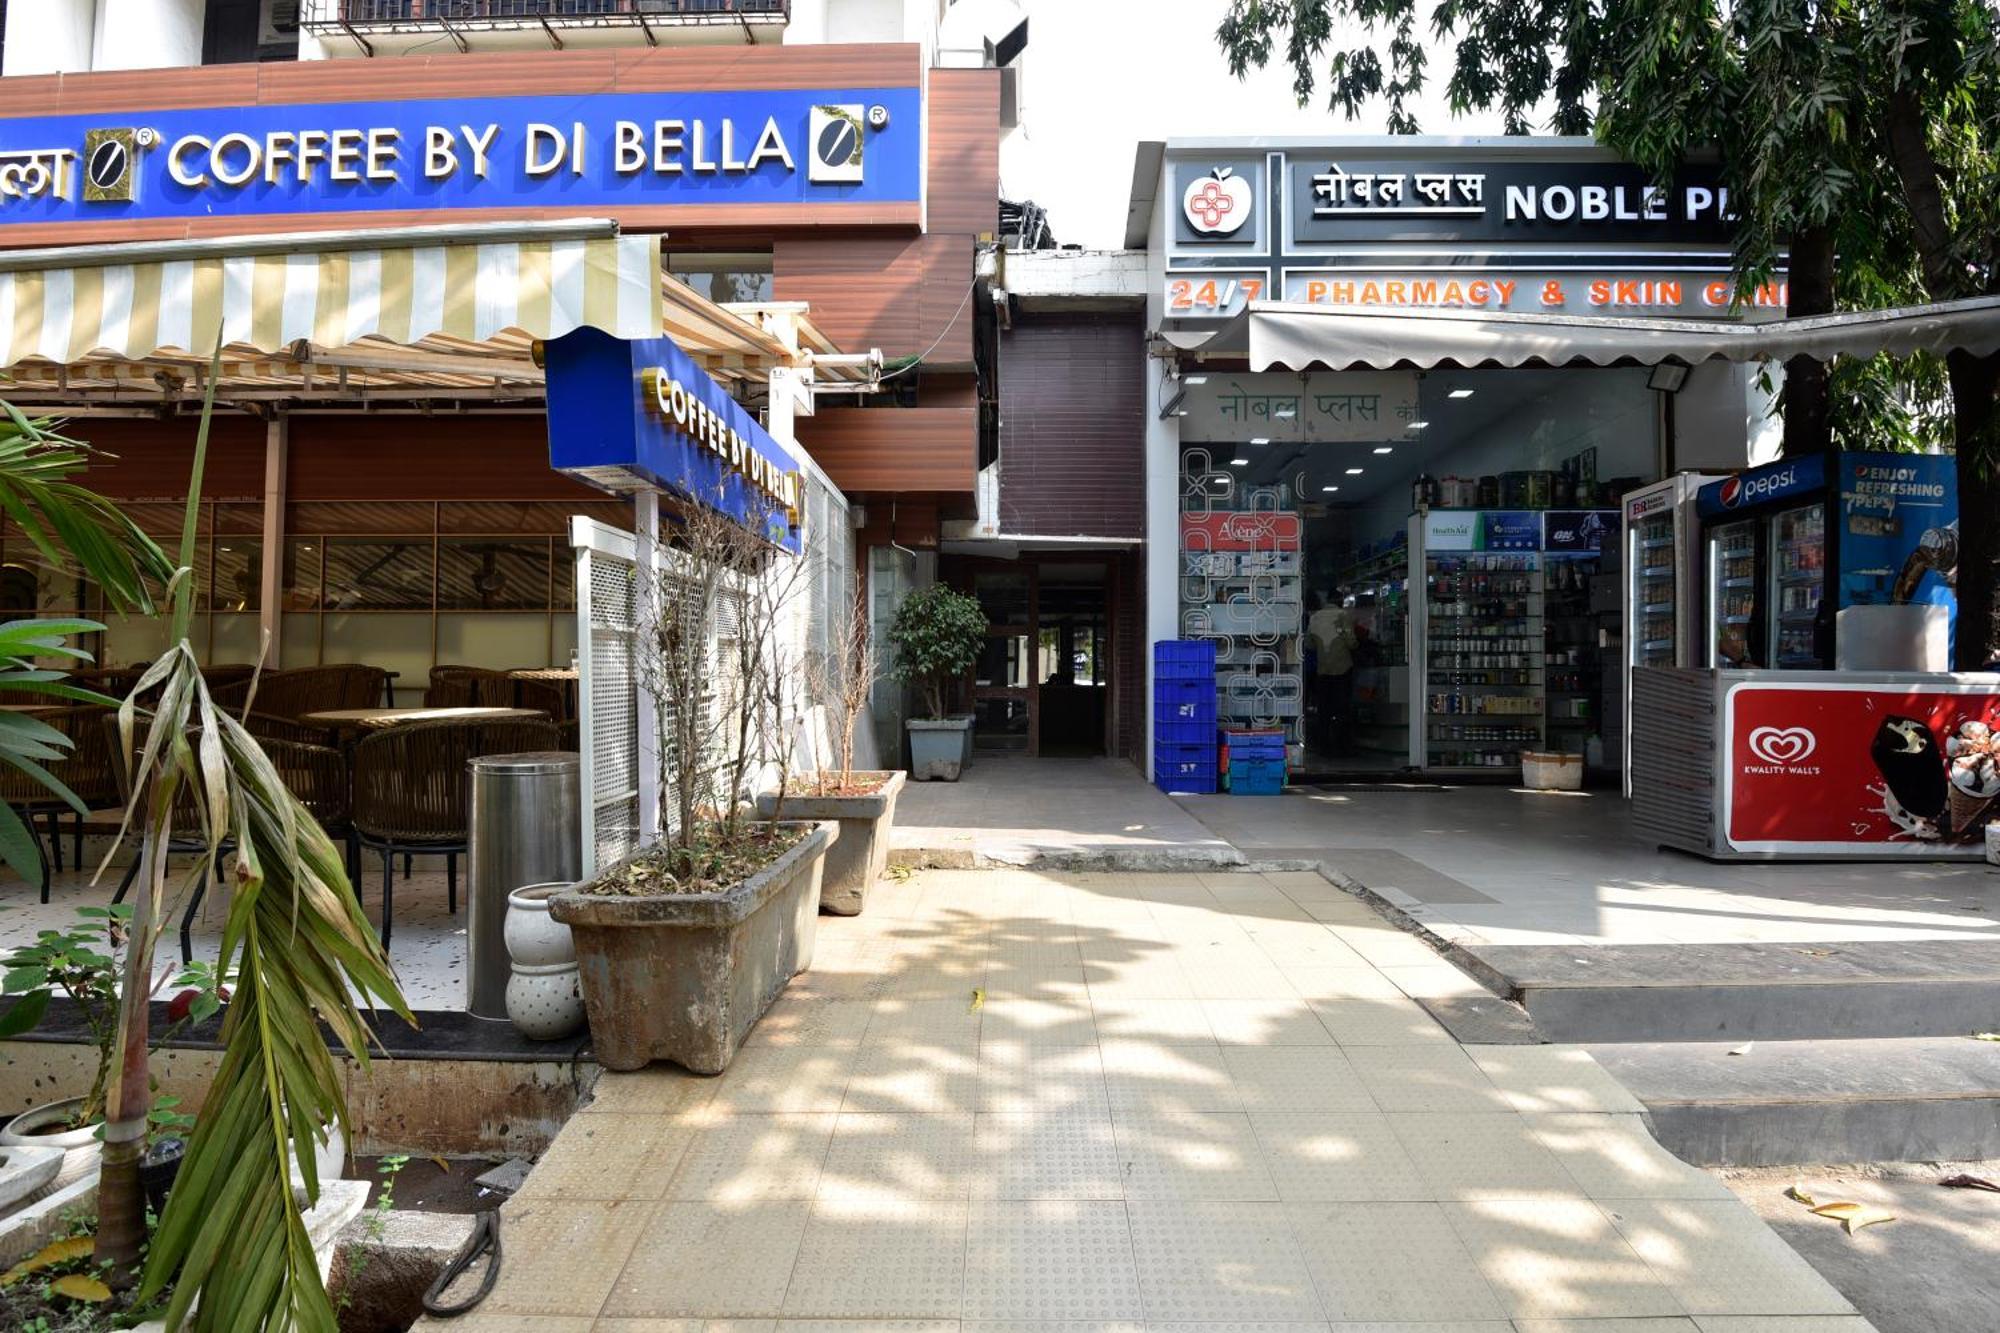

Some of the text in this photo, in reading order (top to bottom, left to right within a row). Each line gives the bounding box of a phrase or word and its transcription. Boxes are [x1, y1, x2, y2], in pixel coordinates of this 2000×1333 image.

[167, 115, 796, 187] COFFEE BY DI BELLA
[1313, 163, 1486, 202] नोबल प्लस
[1505, 185, 1668, 221] NOBLE
[1170, 279, 1263, 309] 24/7
[1307, 279, 1789, 308] PHARMACY & SKIN CR
[656, 366, 797, 508] COFFEE BY DI BEL
[1744, 465, 1796, 501] pepsi
[1856, 481, 1945, 497] REFRESHING
[1871, 467, 1918, 481] ENJOY
[1744, 766, 1821, 775] KWALITY WALL'S
